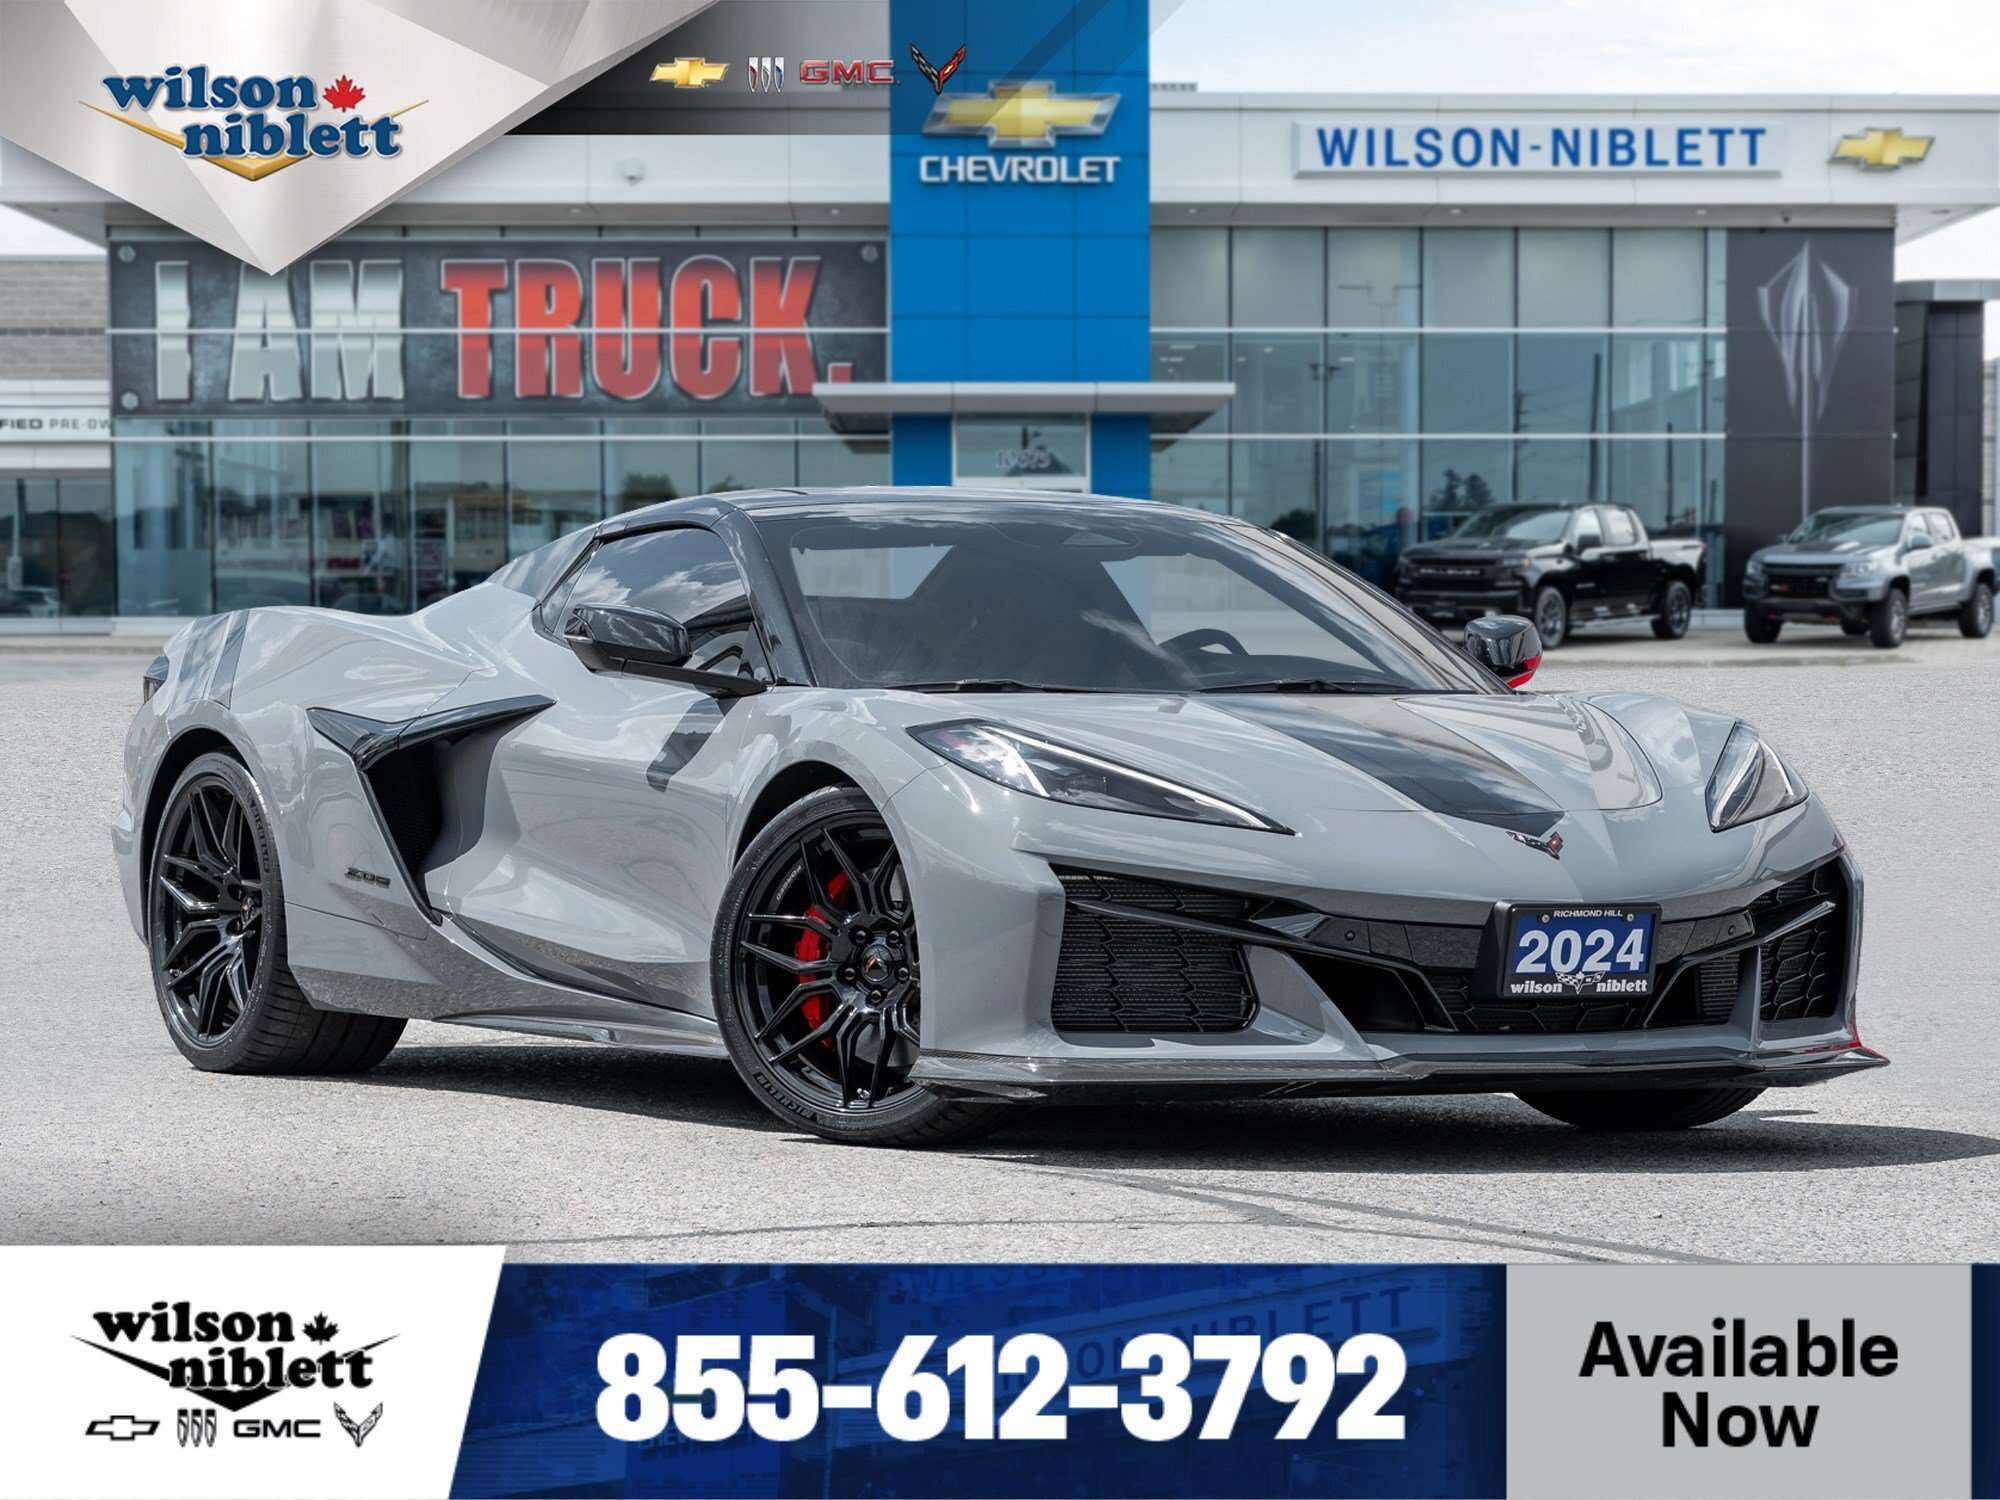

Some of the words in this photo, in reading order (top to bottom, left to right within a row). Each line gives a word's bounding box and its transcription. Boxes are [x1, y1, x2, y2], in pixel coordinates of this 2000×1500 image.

[919, 155, 1120, 184] CHEVROLET
[155, 260, 192, 401] I
[228, 258, 404, 400] AM
[1553, 909, 1602, 918] RICHMOND
[1604, 909, 1623, 917] HILL
[1516, 928, 1644, 974] 2024
[1510, 980, 1563, 994] wilson
[1596, 979, 1648, 993] niblett
